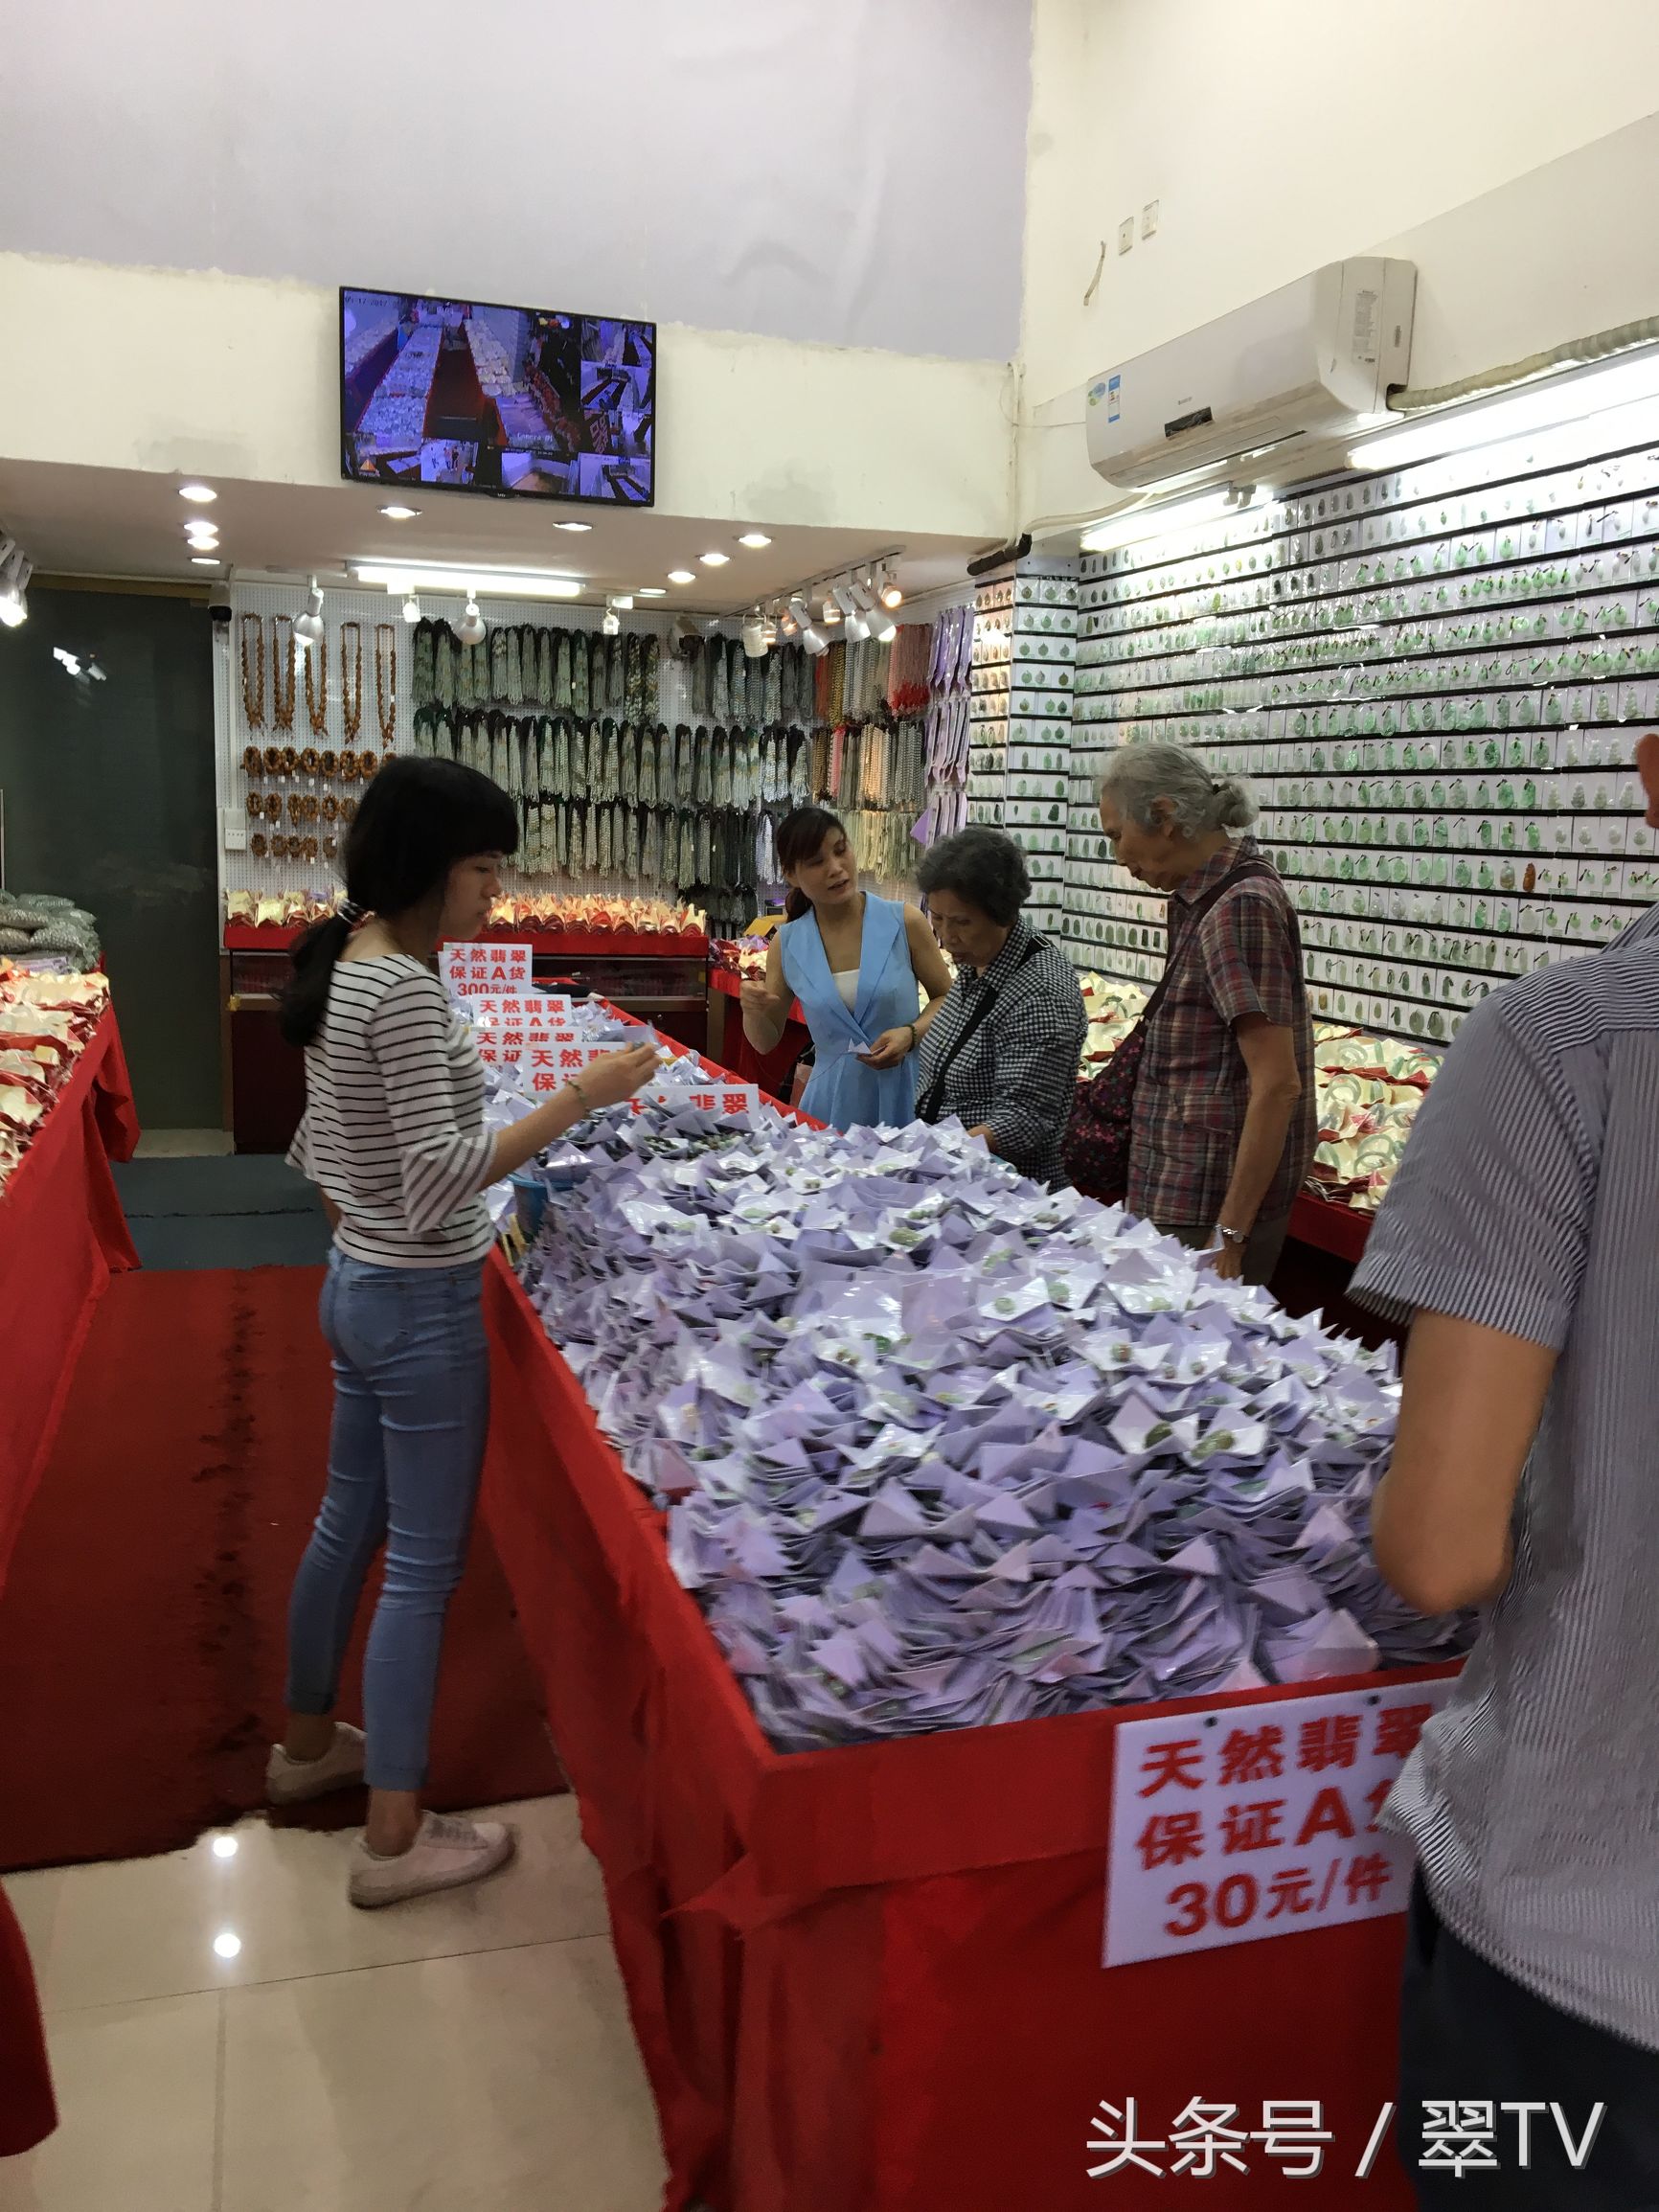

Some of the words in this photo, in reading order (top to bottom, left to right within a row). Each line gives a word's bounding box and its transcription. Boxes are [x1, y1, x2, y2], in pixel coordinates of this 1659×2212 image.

[450, 948, 527, 964] 天然翡翠
[449, 965, 526, 981] 保证A货
[457, 982, 518, 996] 300元/件
[479, 998, 566, 1015] 天然翡翠
[1134, 1777, 1392, 1871] 保证A
[1163, 1853, 1393, 1938] 30元/件
